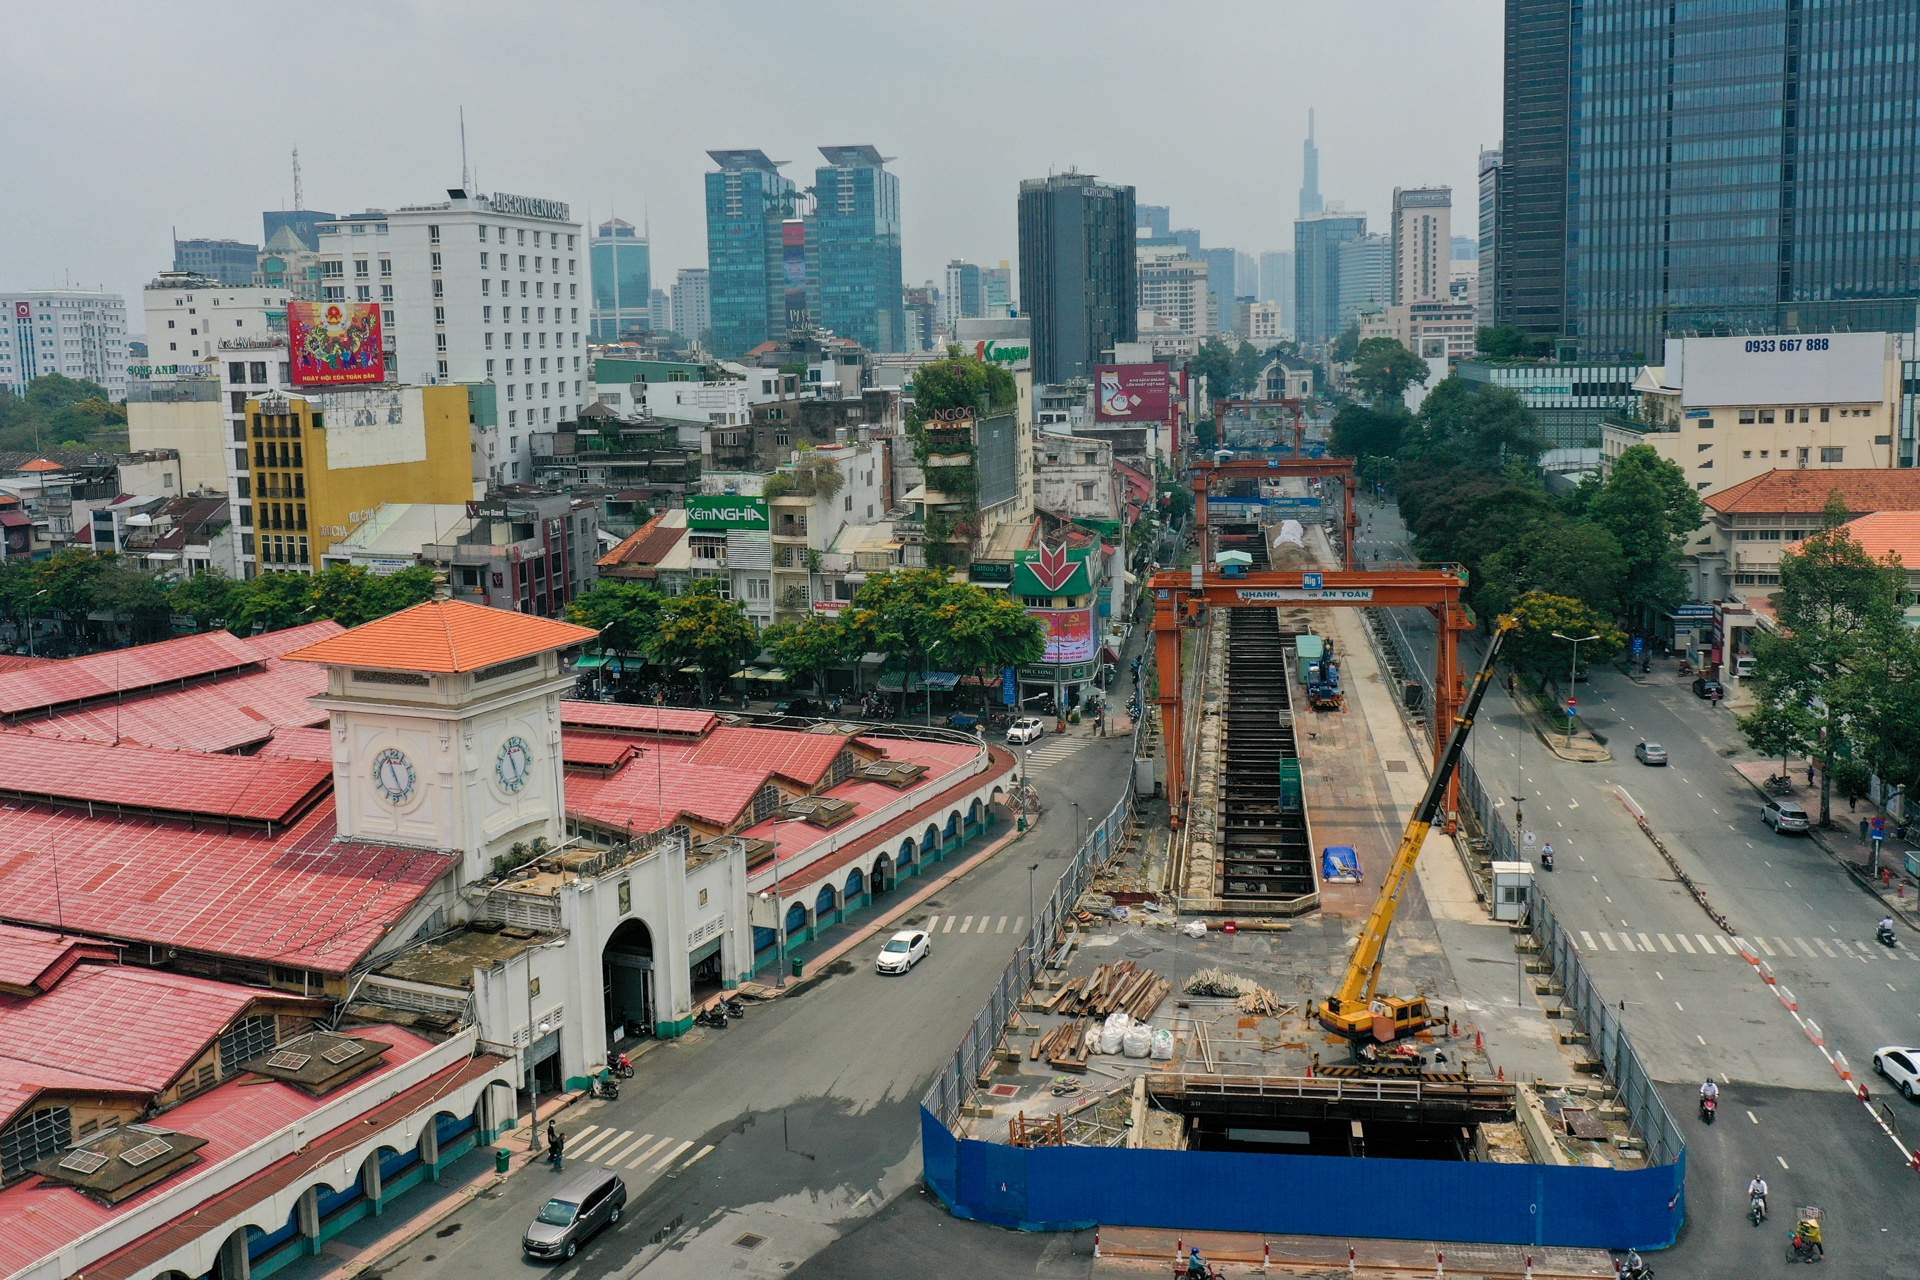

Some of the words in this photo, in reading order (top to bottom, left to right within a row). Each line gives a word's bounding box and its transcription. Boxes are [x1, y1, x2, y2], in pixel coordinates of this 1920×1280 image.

[494, 192, 530, 214] LIBERTY
[529, 197, 570, 220] CENTRAL
[1745, 340, 1776, 353] 0933
[1779, 339, 1802, 352] 667
[1806, 338, 1829, 351] 888
[128, 365, 152, 375] SONG
[154, 365, 176, 375] ANH
[178, 364, 212, 374] HOTEL
[1304, 576, 1316, 586] Rig
[1317, 576, 1321, 584] 1
[1158, 589, 1168, 598] 20T
